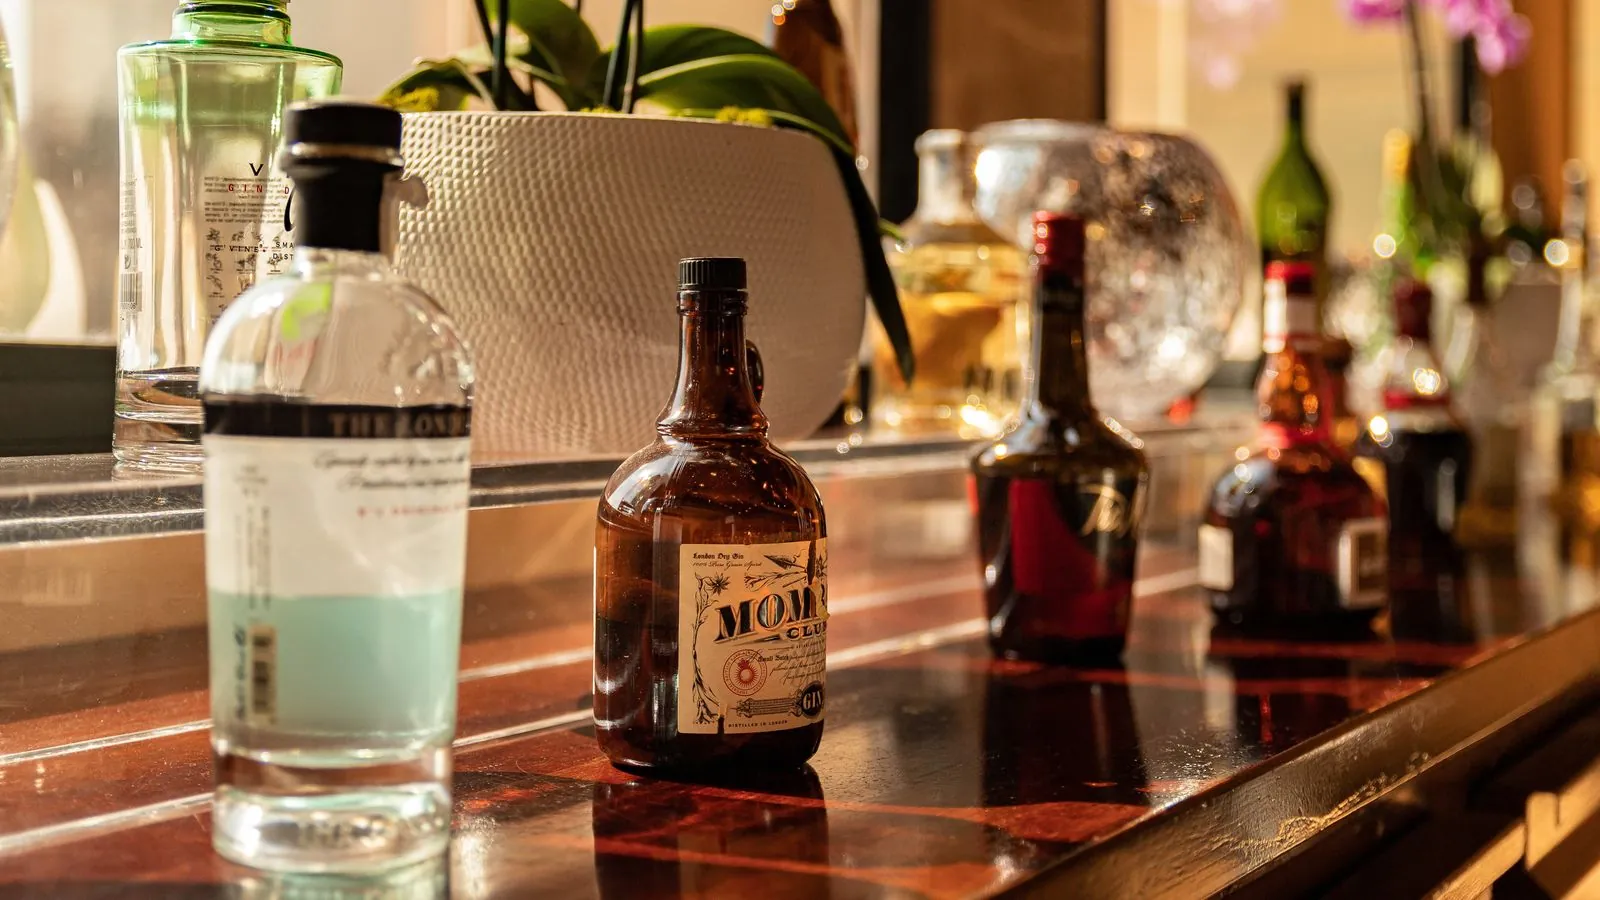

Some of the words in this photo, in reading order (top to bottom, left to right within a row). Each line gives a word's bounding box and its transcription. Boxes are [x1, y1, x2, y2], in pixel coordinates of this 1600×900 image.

[228, 184, 263, 193] GIN
[329, 412, 388, 437] THE
[692, 552, 715, 560] London
[718, 552, 730, 560] Dry
[732, 552, 744, 560] Gin
